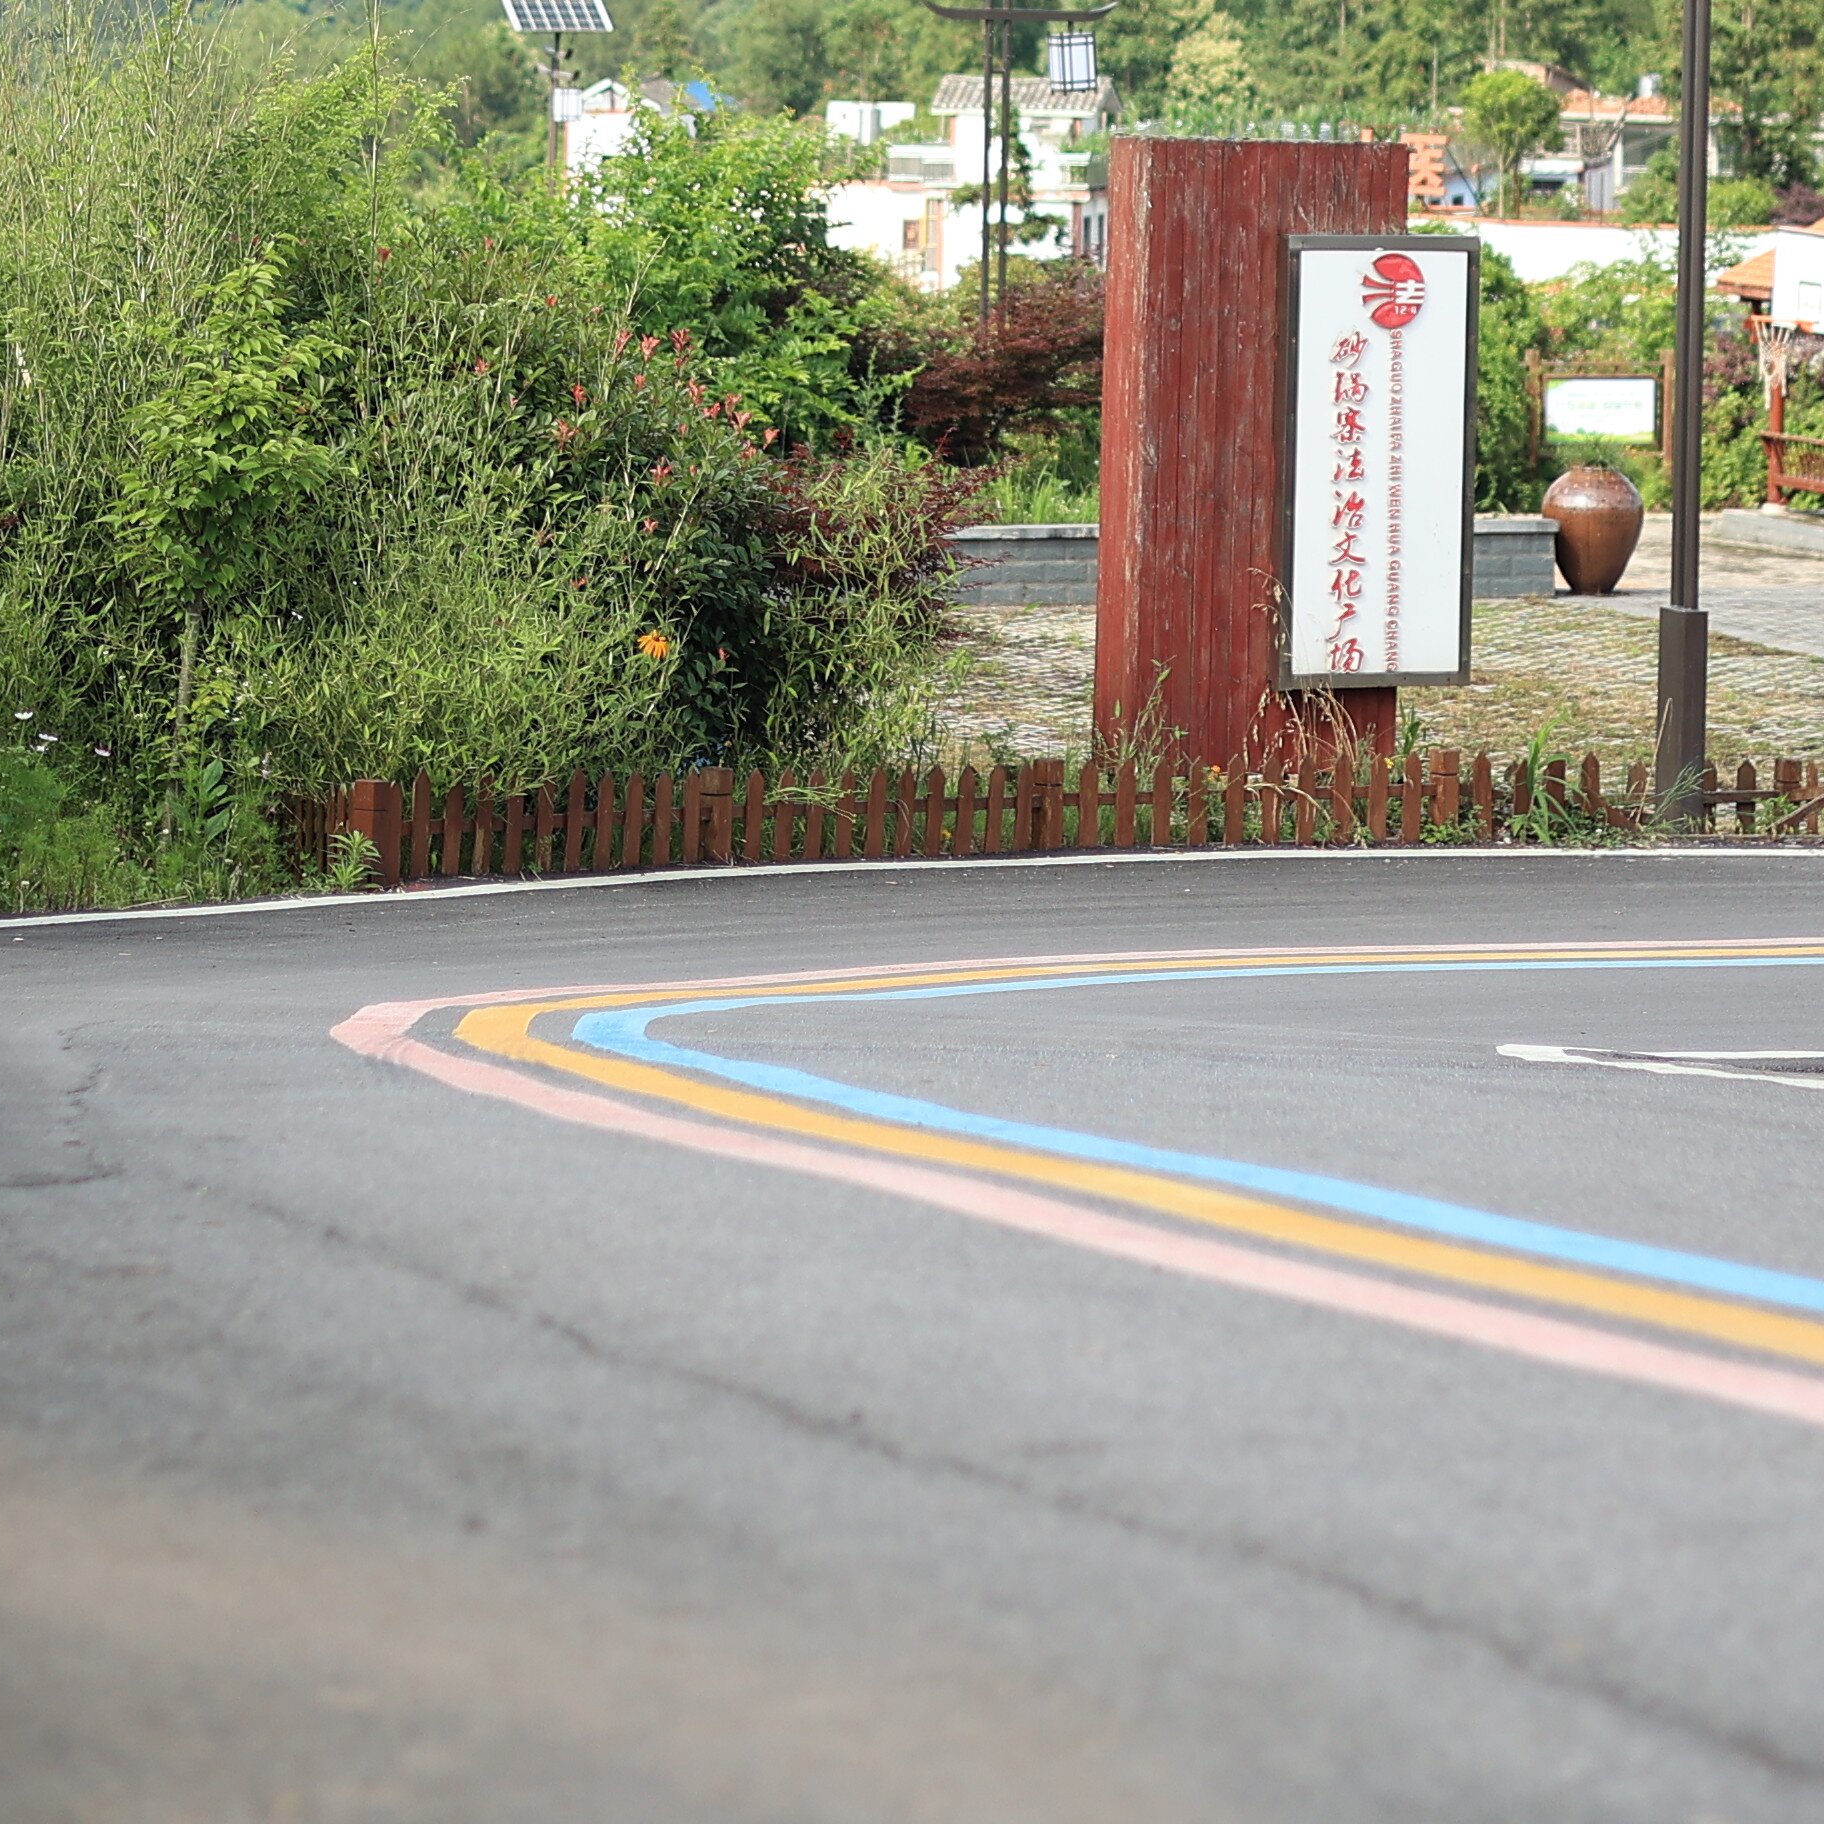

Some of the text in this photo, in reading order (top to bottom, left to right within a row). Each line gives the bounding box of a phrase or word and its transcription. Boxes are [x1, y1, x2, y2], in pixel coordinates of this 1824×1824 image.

[1326, 330, 1369, 673] 砂锅寨法治文化广场
